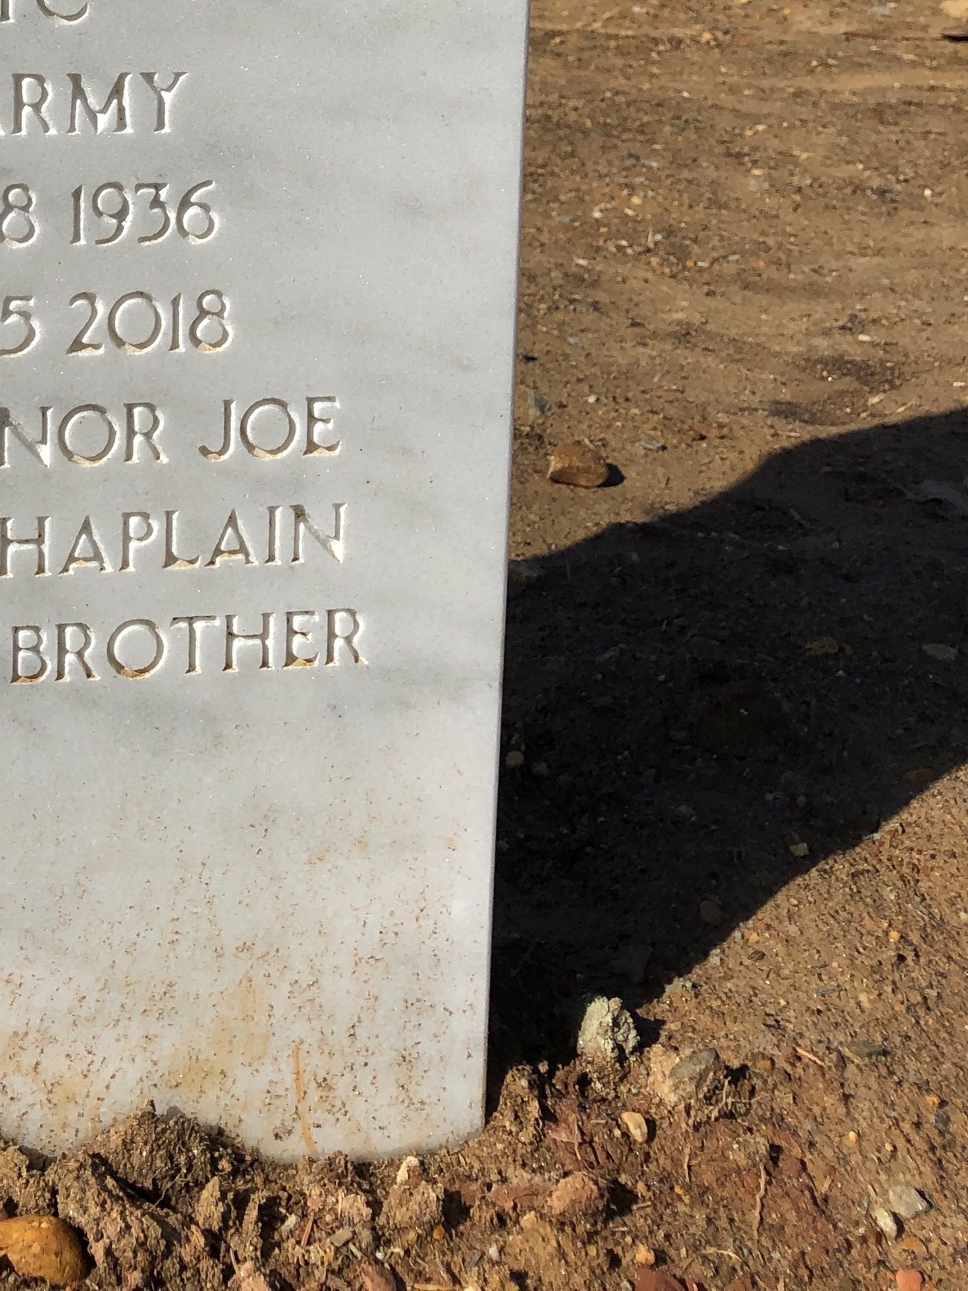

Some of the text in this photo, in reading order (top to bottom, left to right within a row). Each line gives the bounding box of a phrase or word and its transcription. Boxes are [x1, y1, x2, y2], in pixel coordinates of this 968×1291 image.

[71, 179, 221, 245] 1936
[67, 289, 231, 355] 2018
[199, 396, 341, 462] JOE
[9, 608, 368, 685] BROTHER
